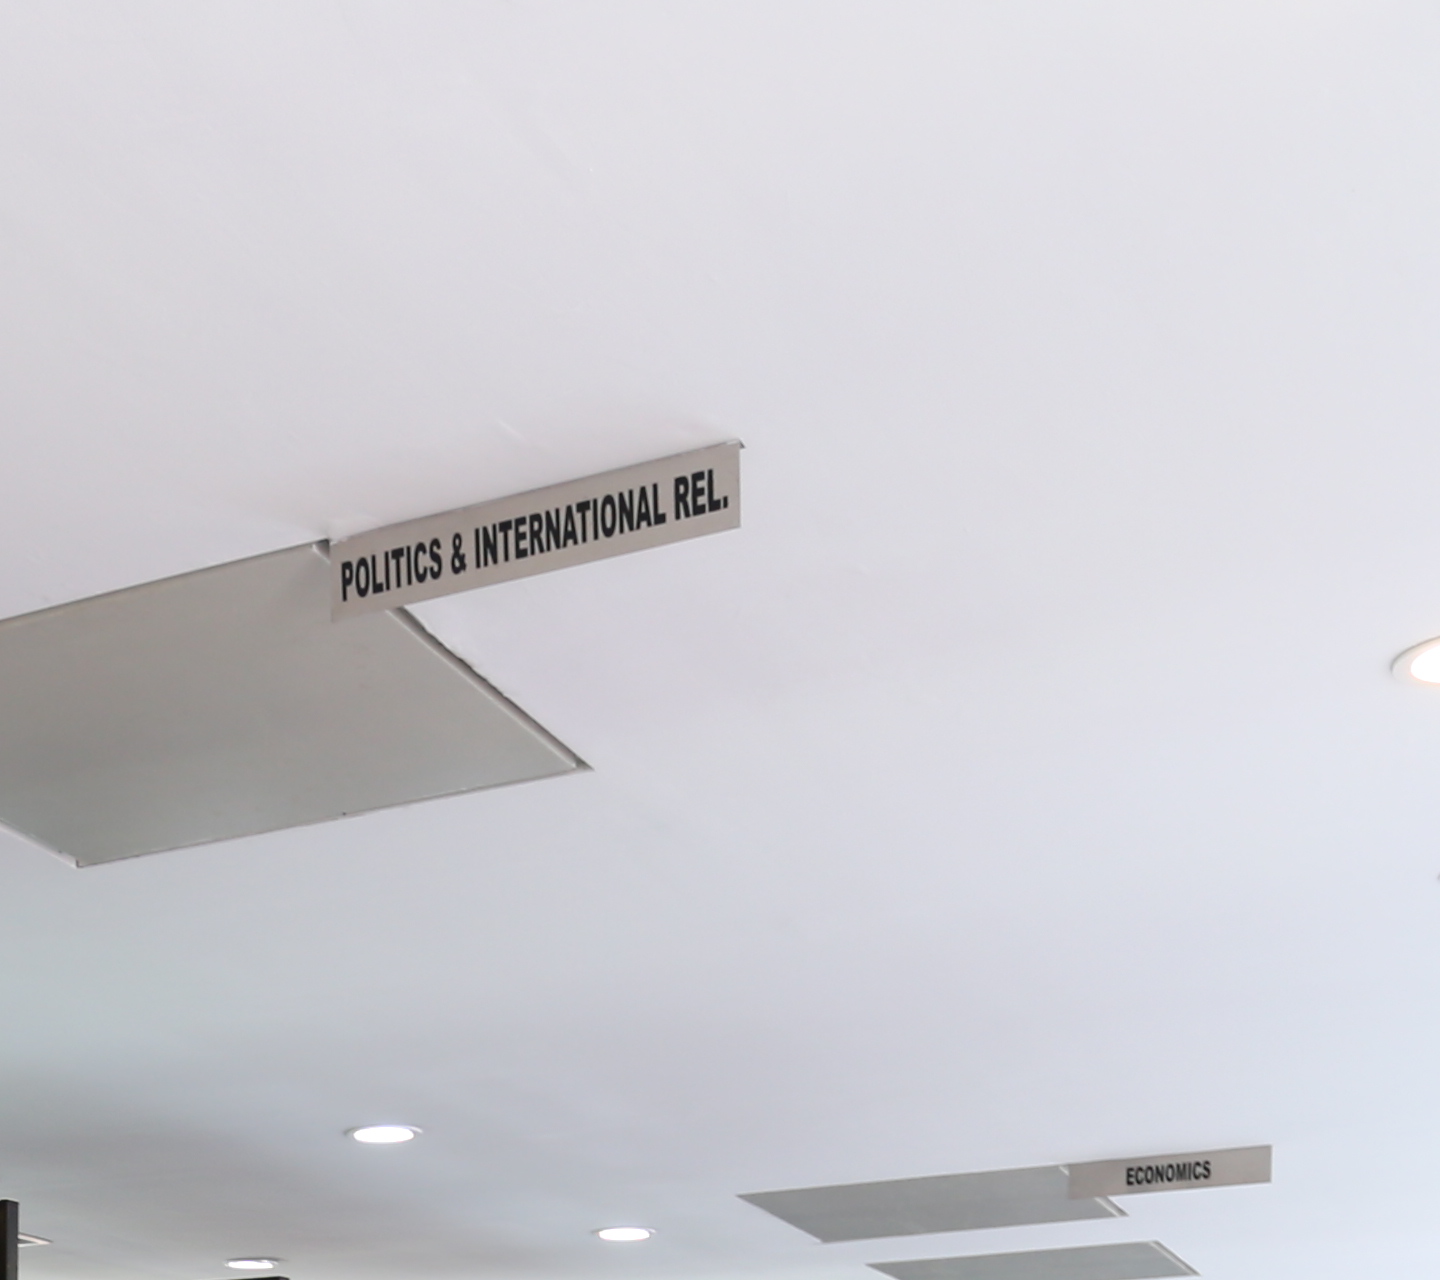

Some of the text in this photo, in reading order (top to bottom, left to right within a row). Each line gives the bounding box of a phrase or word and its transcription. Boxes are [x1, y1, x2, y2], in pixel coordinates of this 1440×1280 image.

[341, 469, 729, 602] POLITICS & INTERNATIONAL REL.
[1126, 1160, 1211, 1186] ECONOMICS
